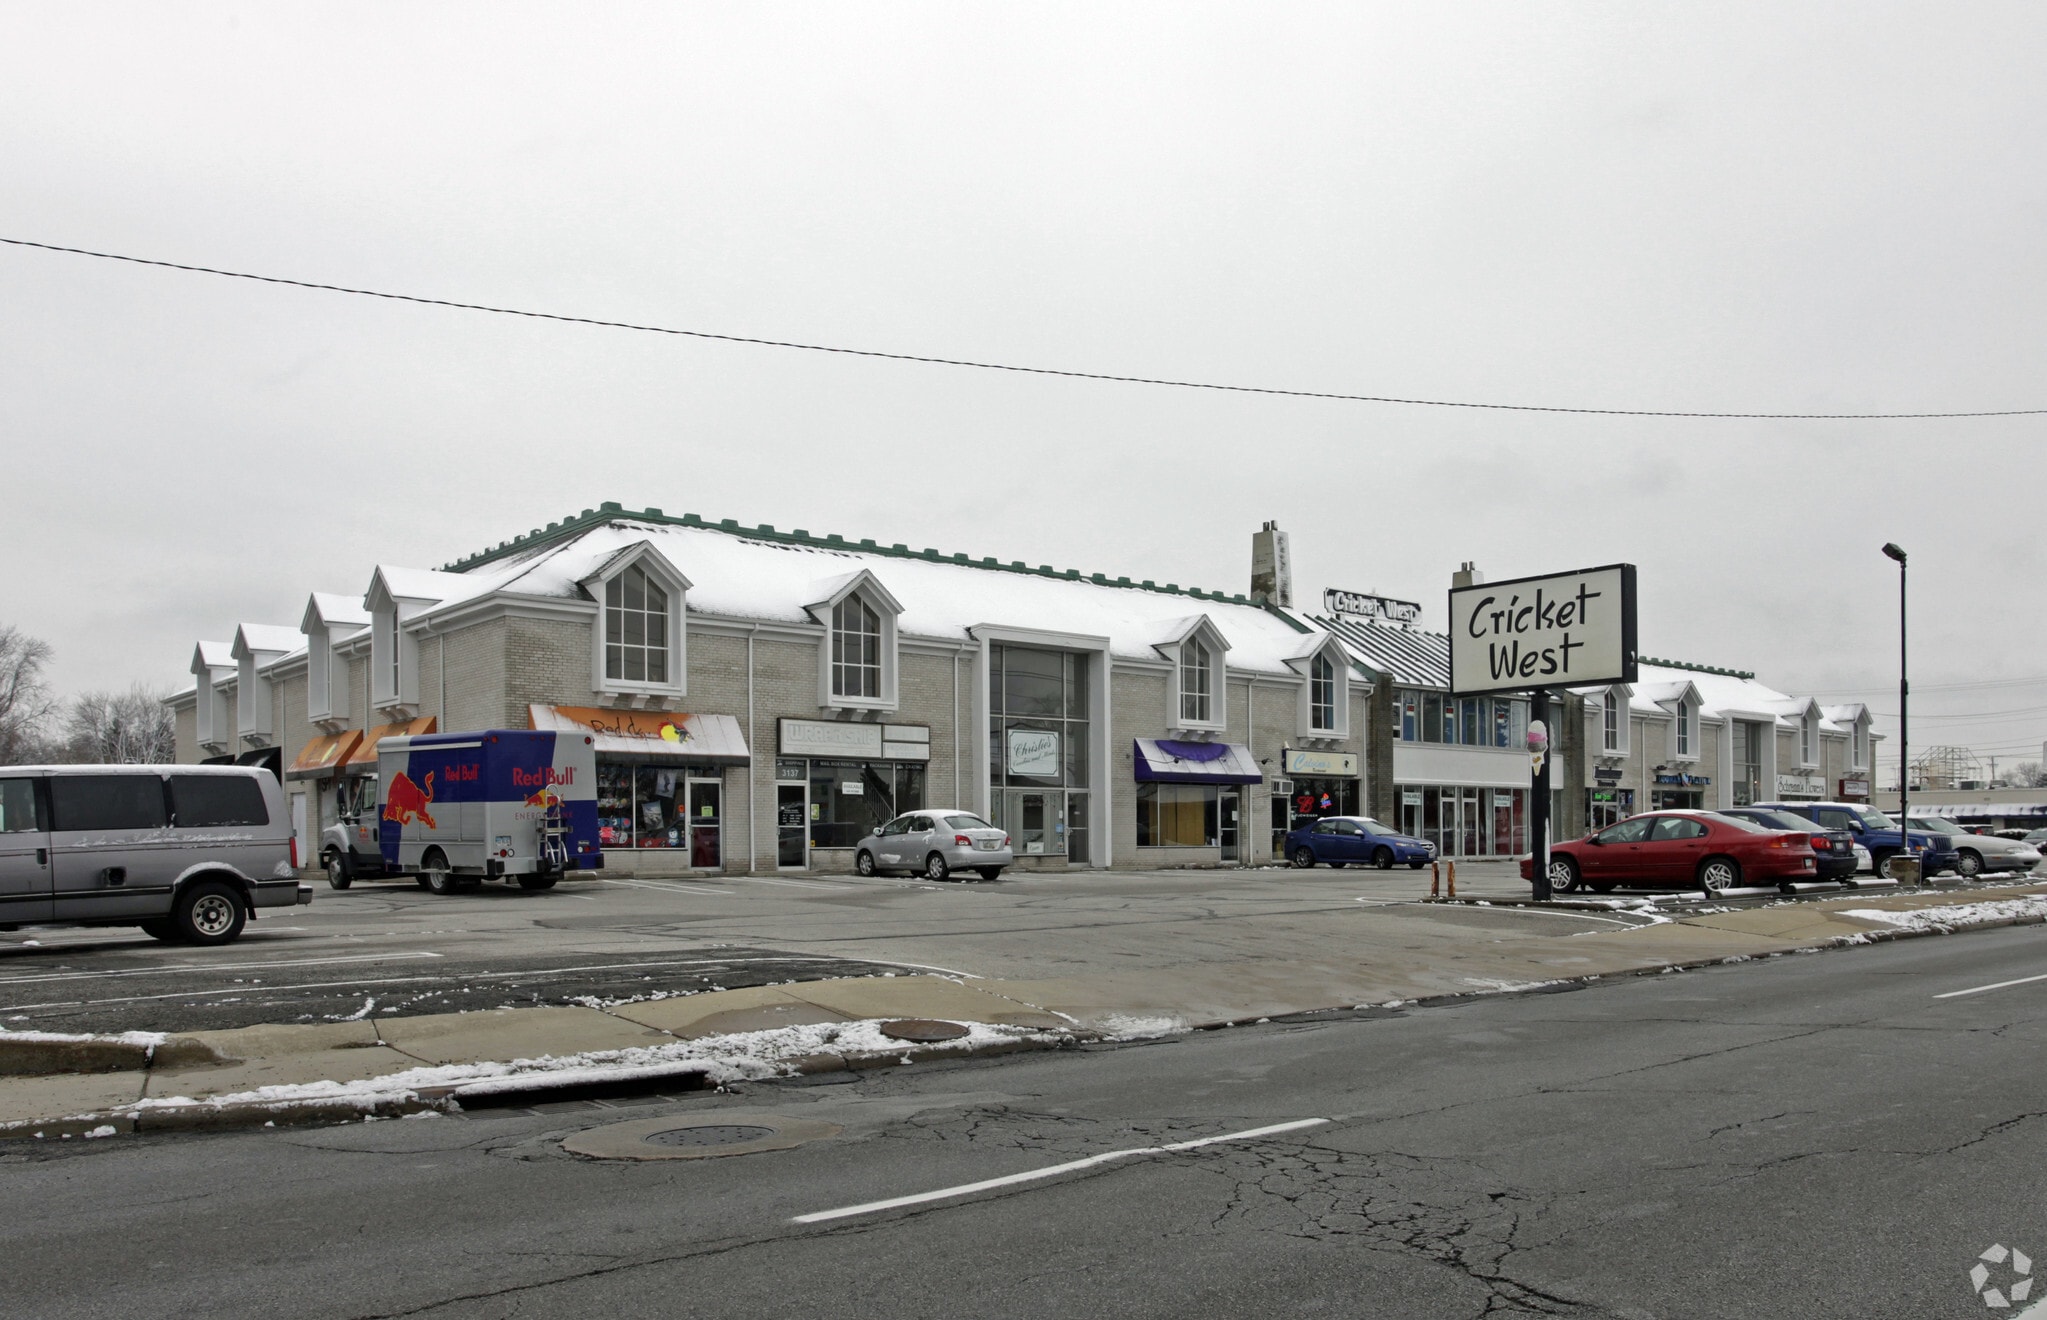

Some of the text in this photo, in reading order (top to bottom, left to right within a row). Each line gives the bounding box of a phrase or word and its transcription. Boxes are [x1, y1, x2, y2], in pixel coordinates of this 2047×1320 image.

[1334, 592, 1417, 622] Cricket West
[1469, 583, 1601, 638] Cricket
[1489, 633, 1584, 680] West
[513, 766, 574, 786] Red Bull
[782, 769, 799, 777] 3137
